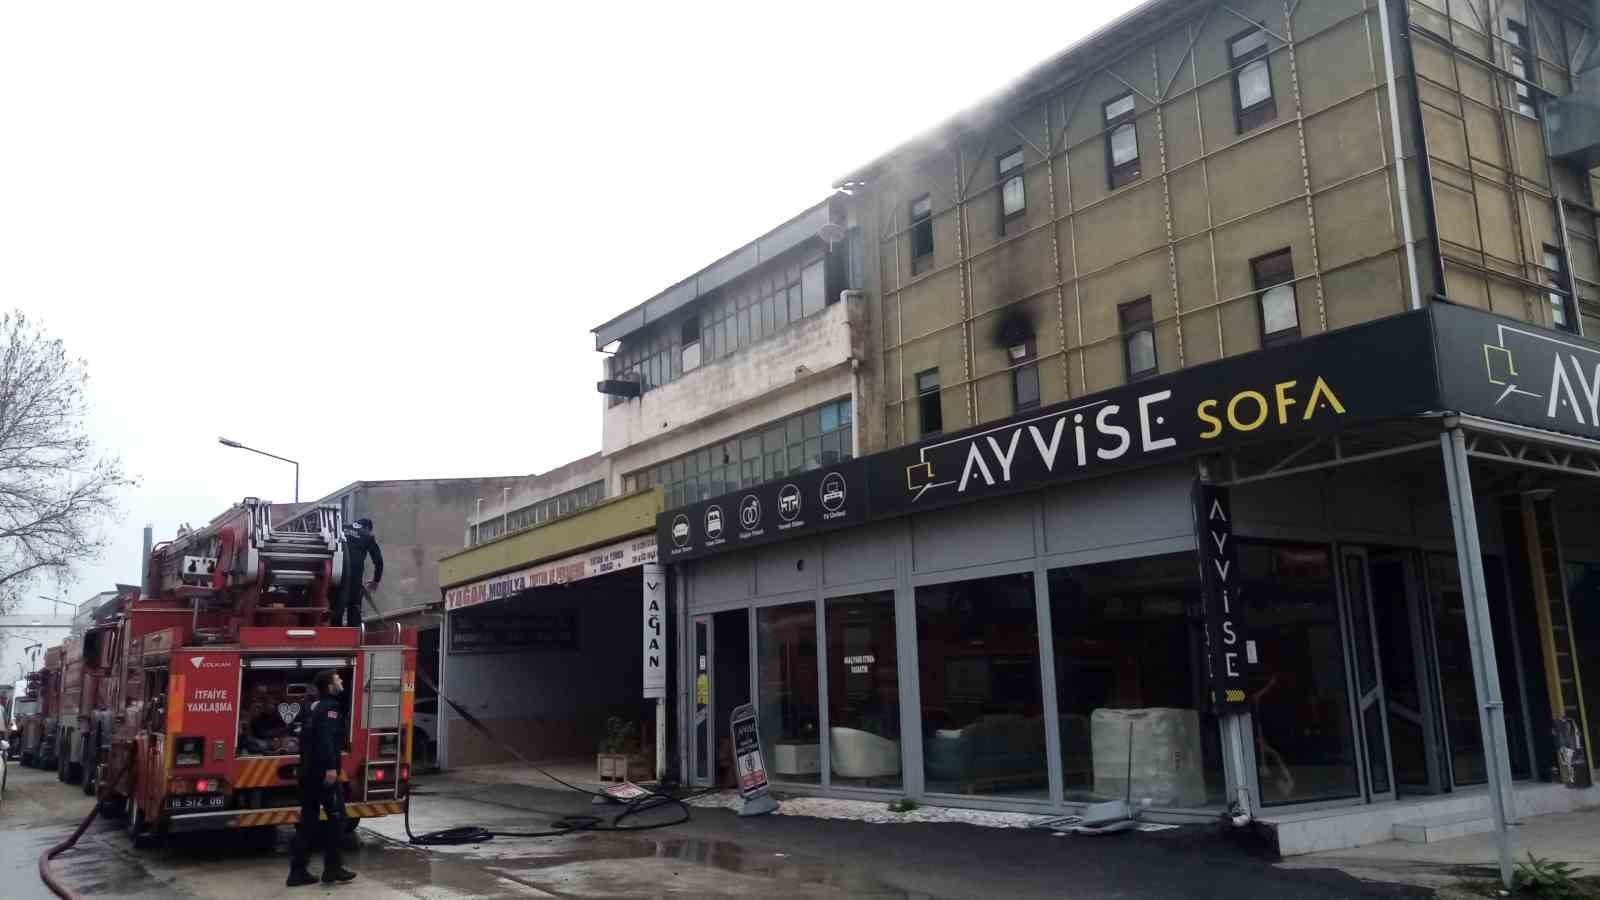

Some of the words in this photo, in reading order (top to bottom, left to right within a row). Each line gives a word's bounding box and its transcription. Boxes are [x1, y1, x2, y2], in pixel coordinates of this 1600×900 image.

[1197, 376, 1346, 438] SOFA
[194, 688, 227, 699] İTFAİYE
[187, 702, 232, 714] YAKLAŞMA
